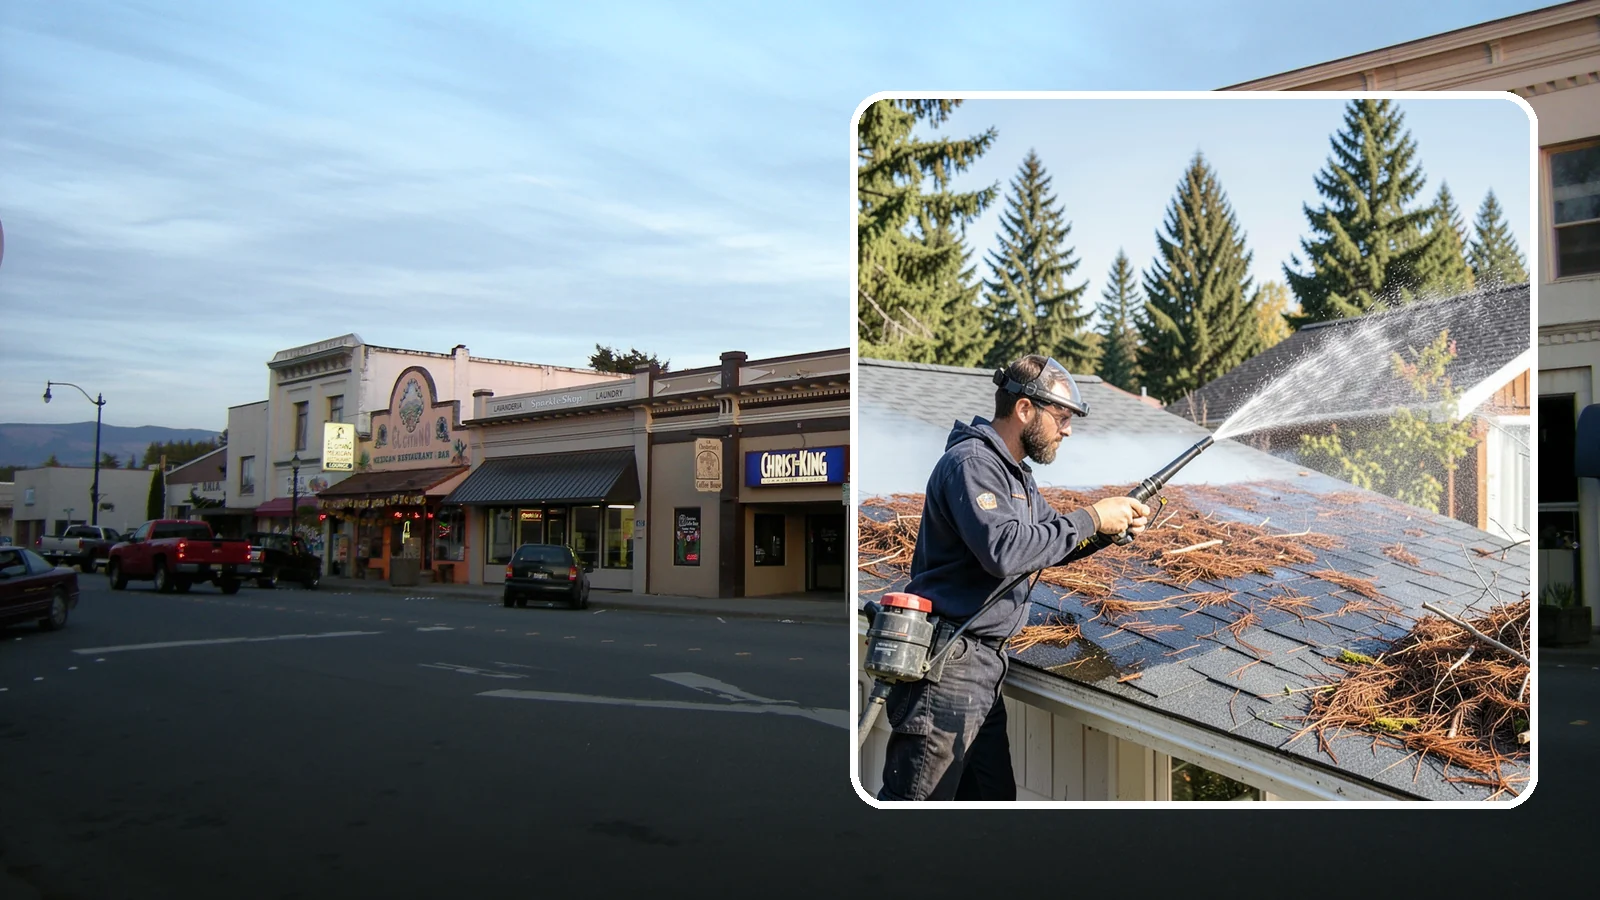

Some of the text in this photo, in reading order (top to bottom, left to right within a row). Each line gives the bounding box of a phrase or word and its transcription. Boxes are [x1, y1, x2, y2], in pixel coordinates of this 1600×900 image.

[493, 389, 624, 413] LAVANDERIA Sparkle Shop LAUNDRY
[373, 450, 450, 464] MEXICAN RESTAURANT BAR
[799, 450, 827, 476] KING
[696, 480, 709, 489] Coffee
